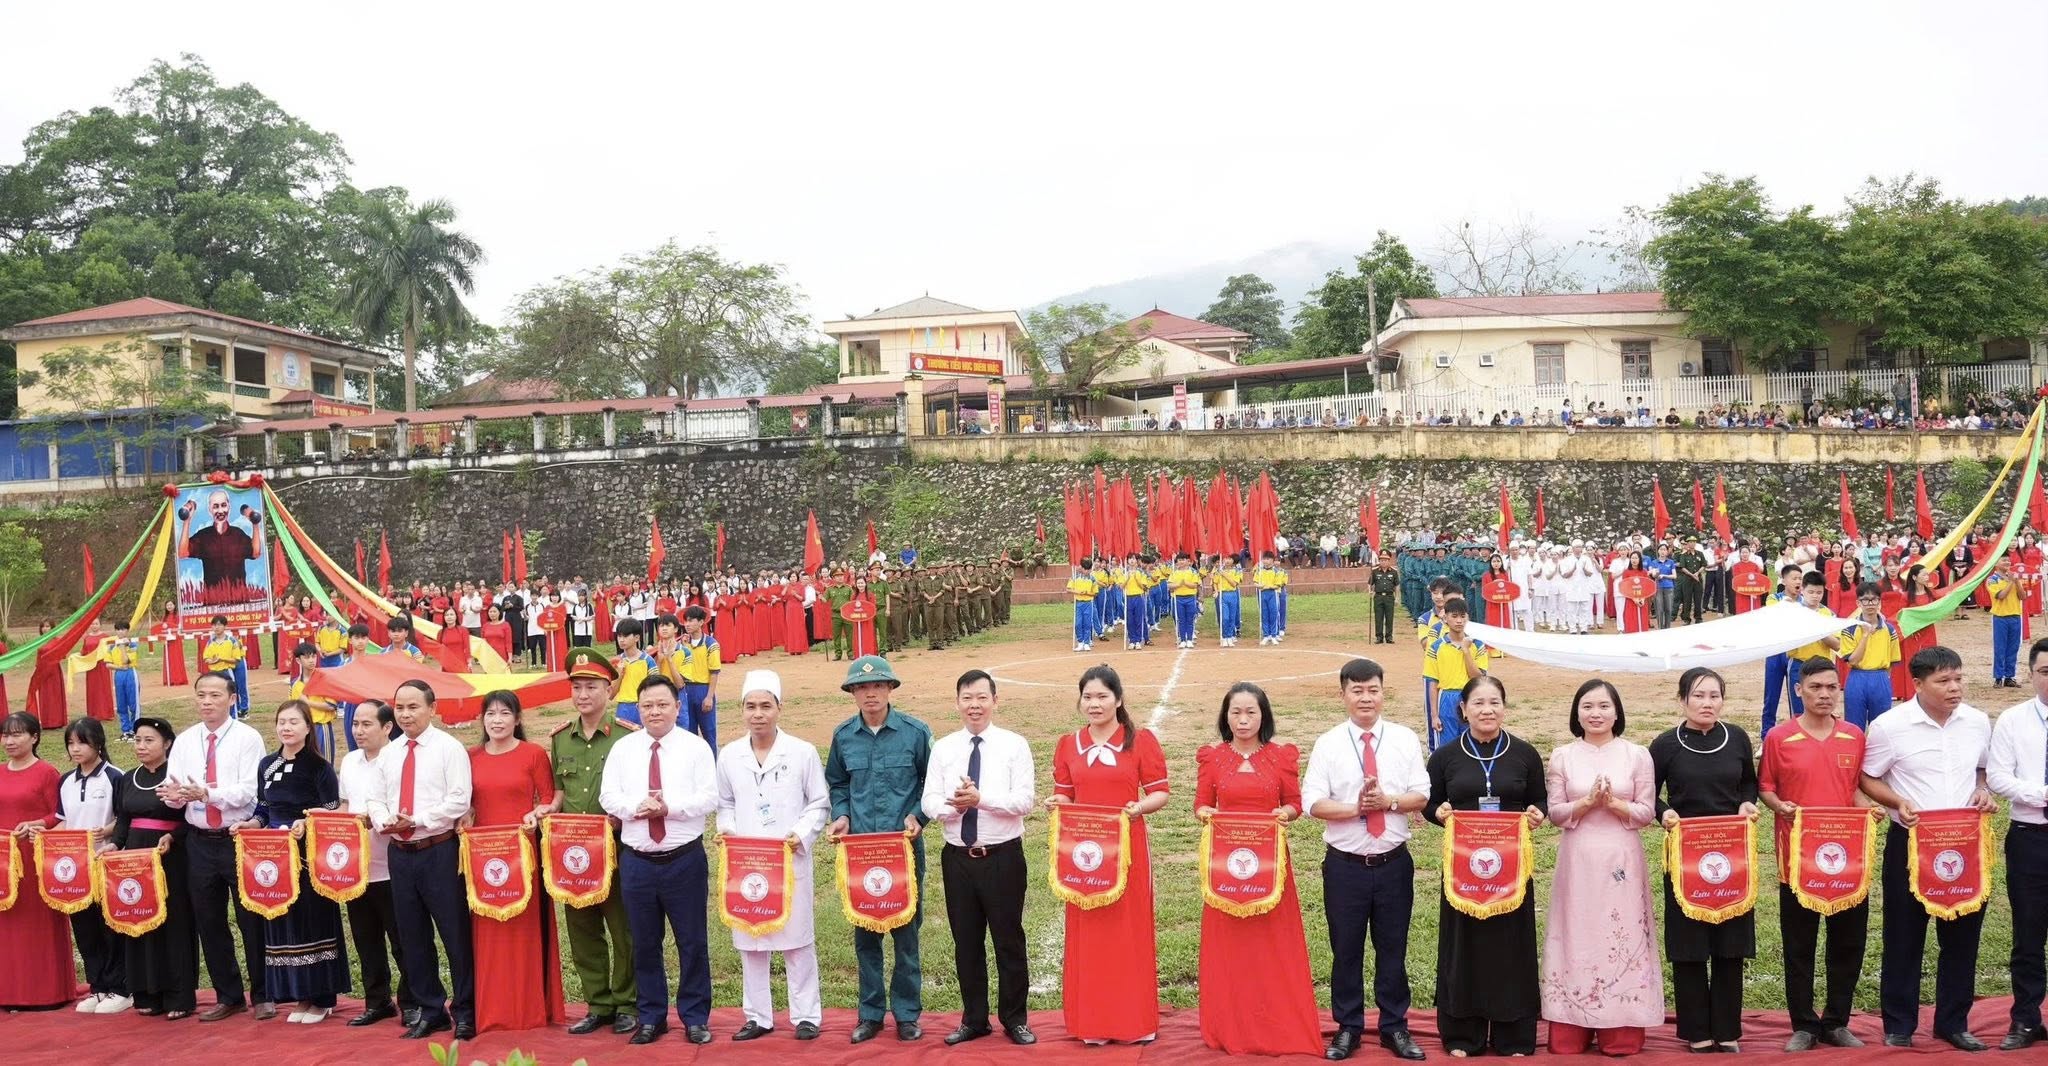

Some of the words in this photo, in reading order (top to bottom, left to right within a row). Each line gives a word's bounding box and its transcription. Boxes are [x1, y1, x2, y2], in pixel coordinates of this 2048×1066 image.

[927, 356, 949, 368] TRƯỜNG
[950, 356, 961, 370] TIỂU
[962, 361, 973, 372] HỌC
[575, 878, 599, 886] Niệm
[1085, 876, 1110, 886] Niệm
[1828, 880, 1855, 888] Niệm
[1240, 884, 1266, 893] Niệm
[1482, 883, 1510, 892] Niệm
[1947, 886, 1973, 895] Niệm
[1713, 888, 1740, 897] Niệm
[877, 901, 902, 909] Niệm
